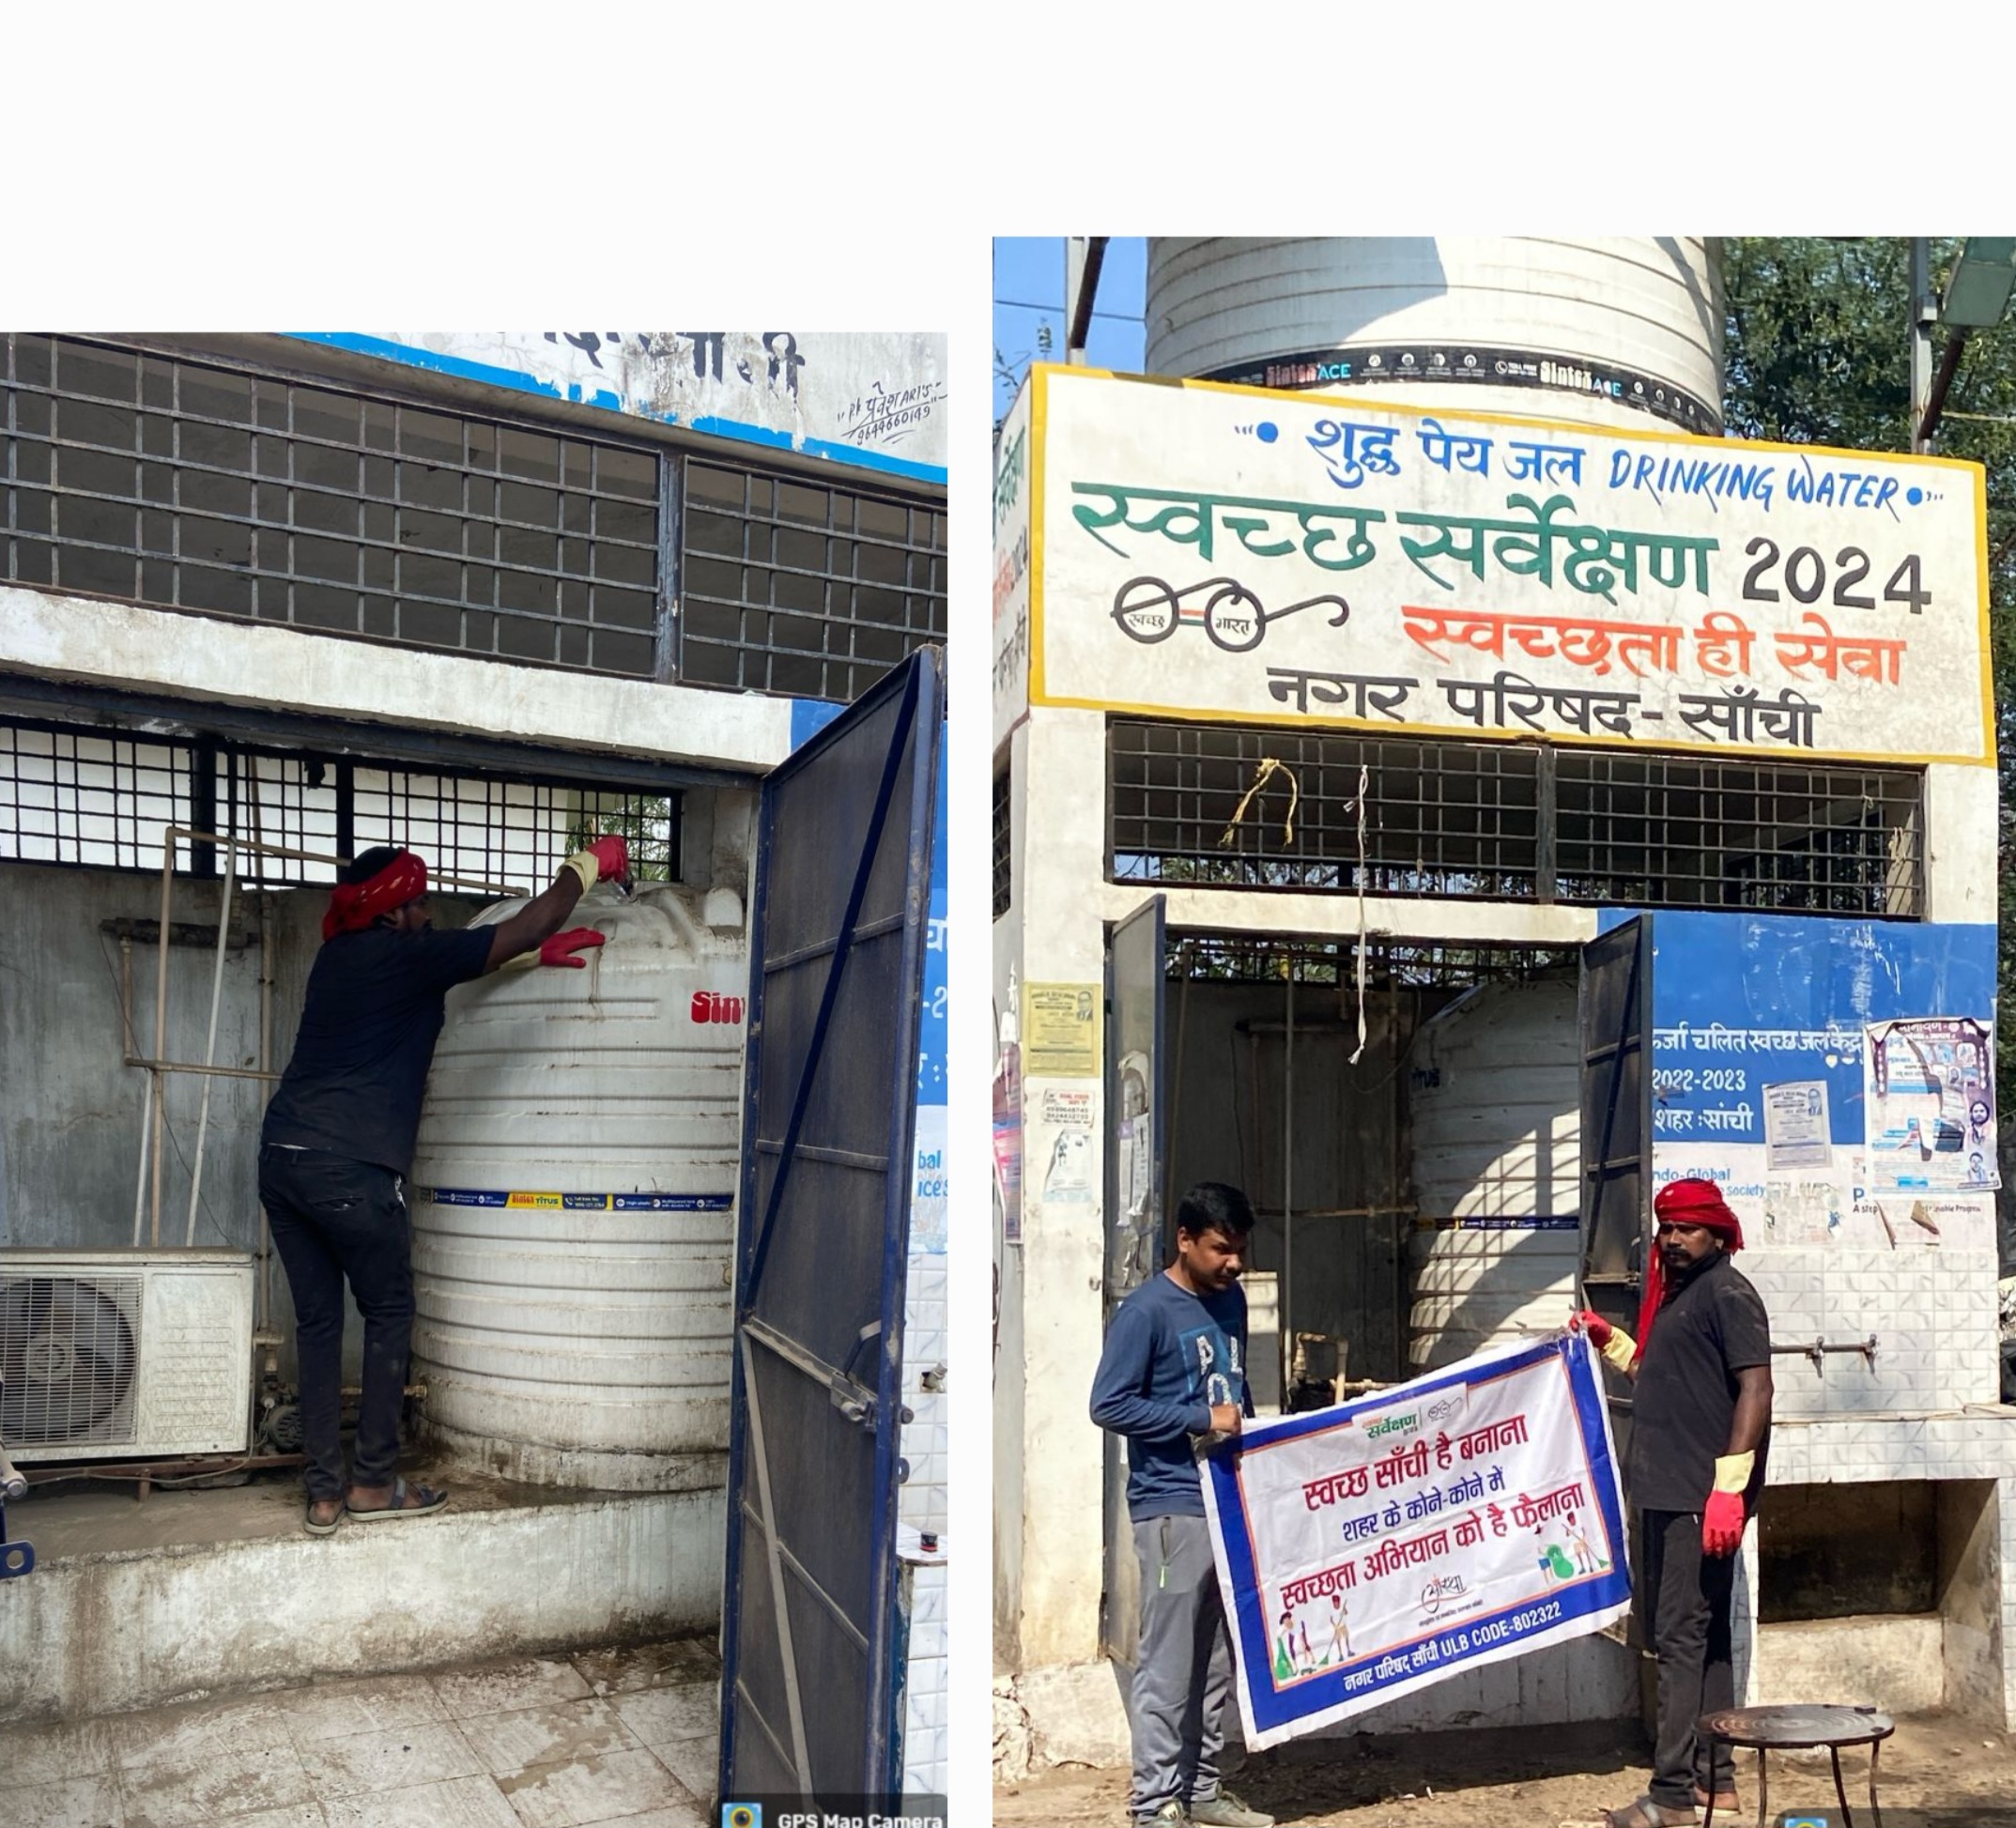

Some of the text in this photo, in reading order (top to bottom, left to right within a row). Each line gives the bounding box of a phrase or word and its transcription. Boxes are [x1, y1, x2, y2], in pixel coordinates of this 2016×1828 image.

[1317, 363, 1352, 379] ACE
[1540, 361, 1593, 390] Sintex
[1306, 418, 1901, 524] शुद्ध पेय जल DRINKING WATER
[1071, 482, 1932, 615] स्वच्छ सर्वेक्षण 2024
[1215, 617, 1251, 637] भारत
[1401, 606, 1907, 687] स्वच्छता ही सेवा
[1266, 667, 1421, 723] नगर
[1691, 1022, 1747, 1053] चलित
[1302, 1415, 1529, 1511] स्वच्छ साँची है बनाना
[1342, 1465, 1506, 1542] शहर के कोने-कोने में
[1280, 1482, 1586, 1611] स्वच्छता अभियान को है फैलाना
[1344, 1666, 1374, 1692] नगर
[1412, 1641, 1439, 1667] साँची
[1441, 1634, 1470, 1657] ULB
[1471, 1600, 1562, 1646] CODE-802322
